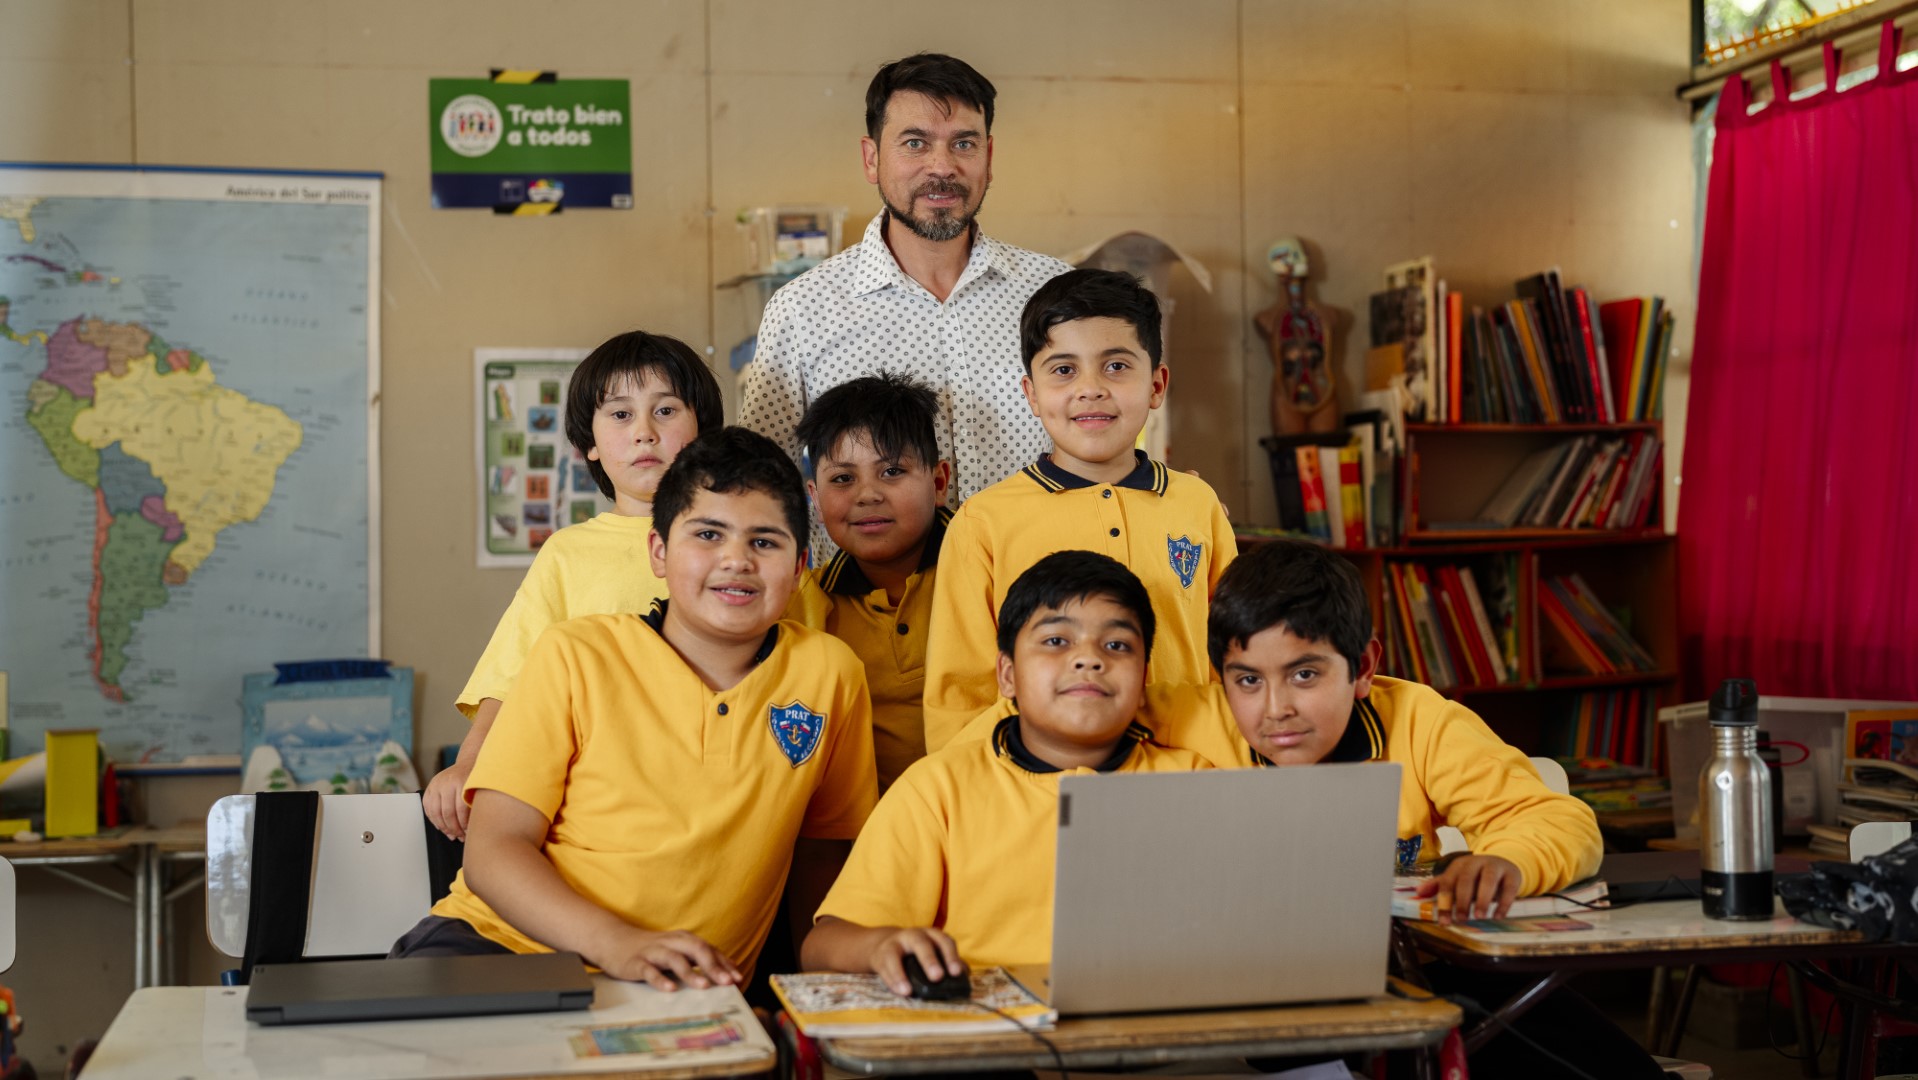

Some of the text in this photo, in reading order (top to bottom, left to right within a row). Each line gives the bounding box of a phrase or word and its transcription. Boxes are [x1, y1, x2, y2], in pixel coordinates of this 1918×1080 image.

[507, 104, 570, 125] Trato
[574, 104, 622, 125] bien
[507, 127, 591, 145] a todos
[1176, 542, 1192, 550] PRAT
[785, 709, 809, 720] PRAT
